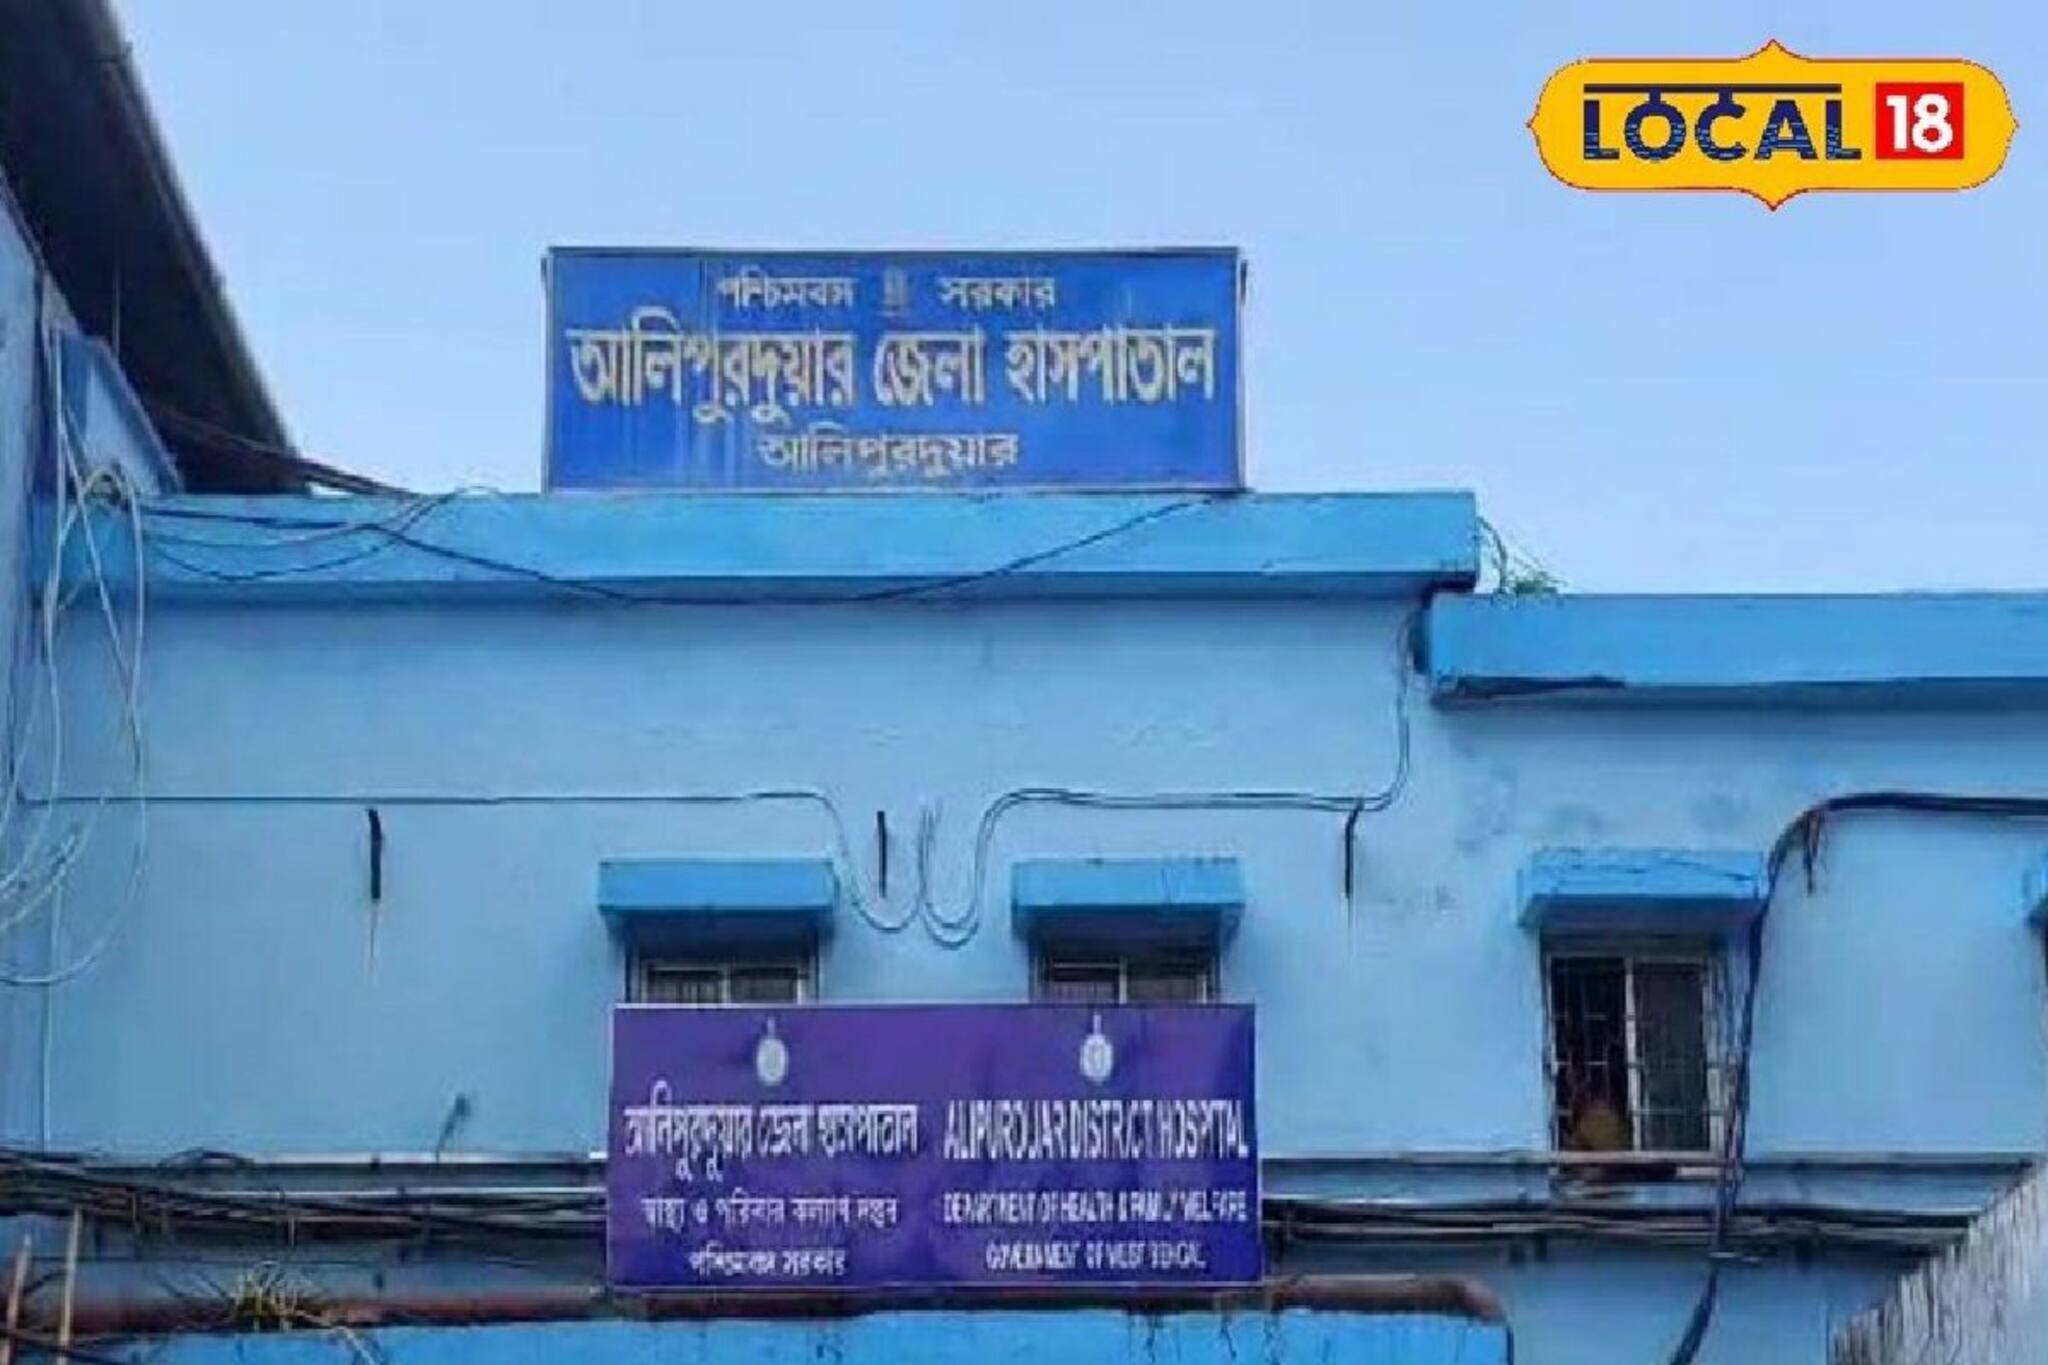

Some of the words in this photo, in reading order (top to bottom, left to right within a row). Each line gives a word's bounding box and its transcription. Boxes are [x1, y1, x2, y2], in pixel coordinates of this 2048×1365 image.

[564, 306, 857, 423] আলিপুরদুয়ার
[874, 326, 986, 406] জেলা
[1004, 324, 1216, 405] হাসপাতাল
[1069, 1099, 1153, 1160] DISTRICT
[1156, 1099, 1249, 1160] HOSPITAL
